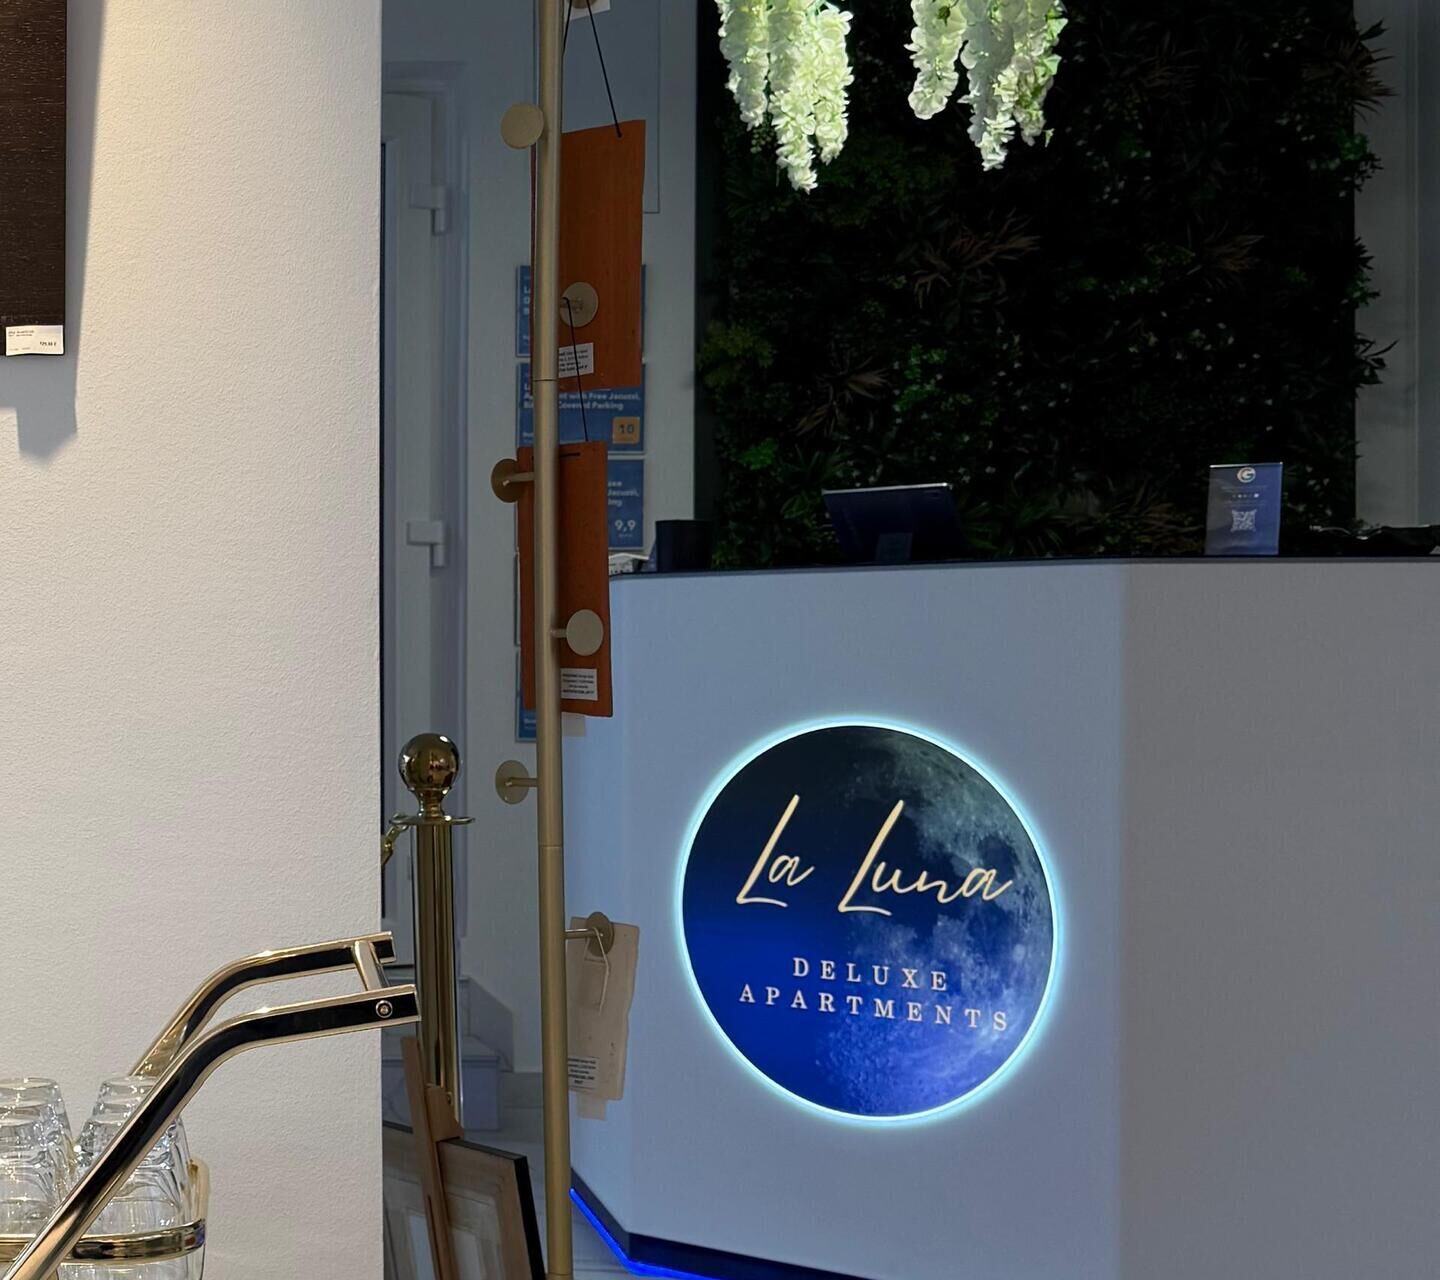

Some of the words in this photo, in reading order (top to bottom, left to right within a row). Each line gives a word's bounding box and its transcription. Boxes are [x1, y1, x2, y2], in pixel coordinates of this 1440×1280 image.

[735, 794, 816, 908] La
[837, 799, 1013, 916] Luna
[792, 956, 948, 992] DELUXE
[738, 983, 1008, 1032] APARTMENTS
